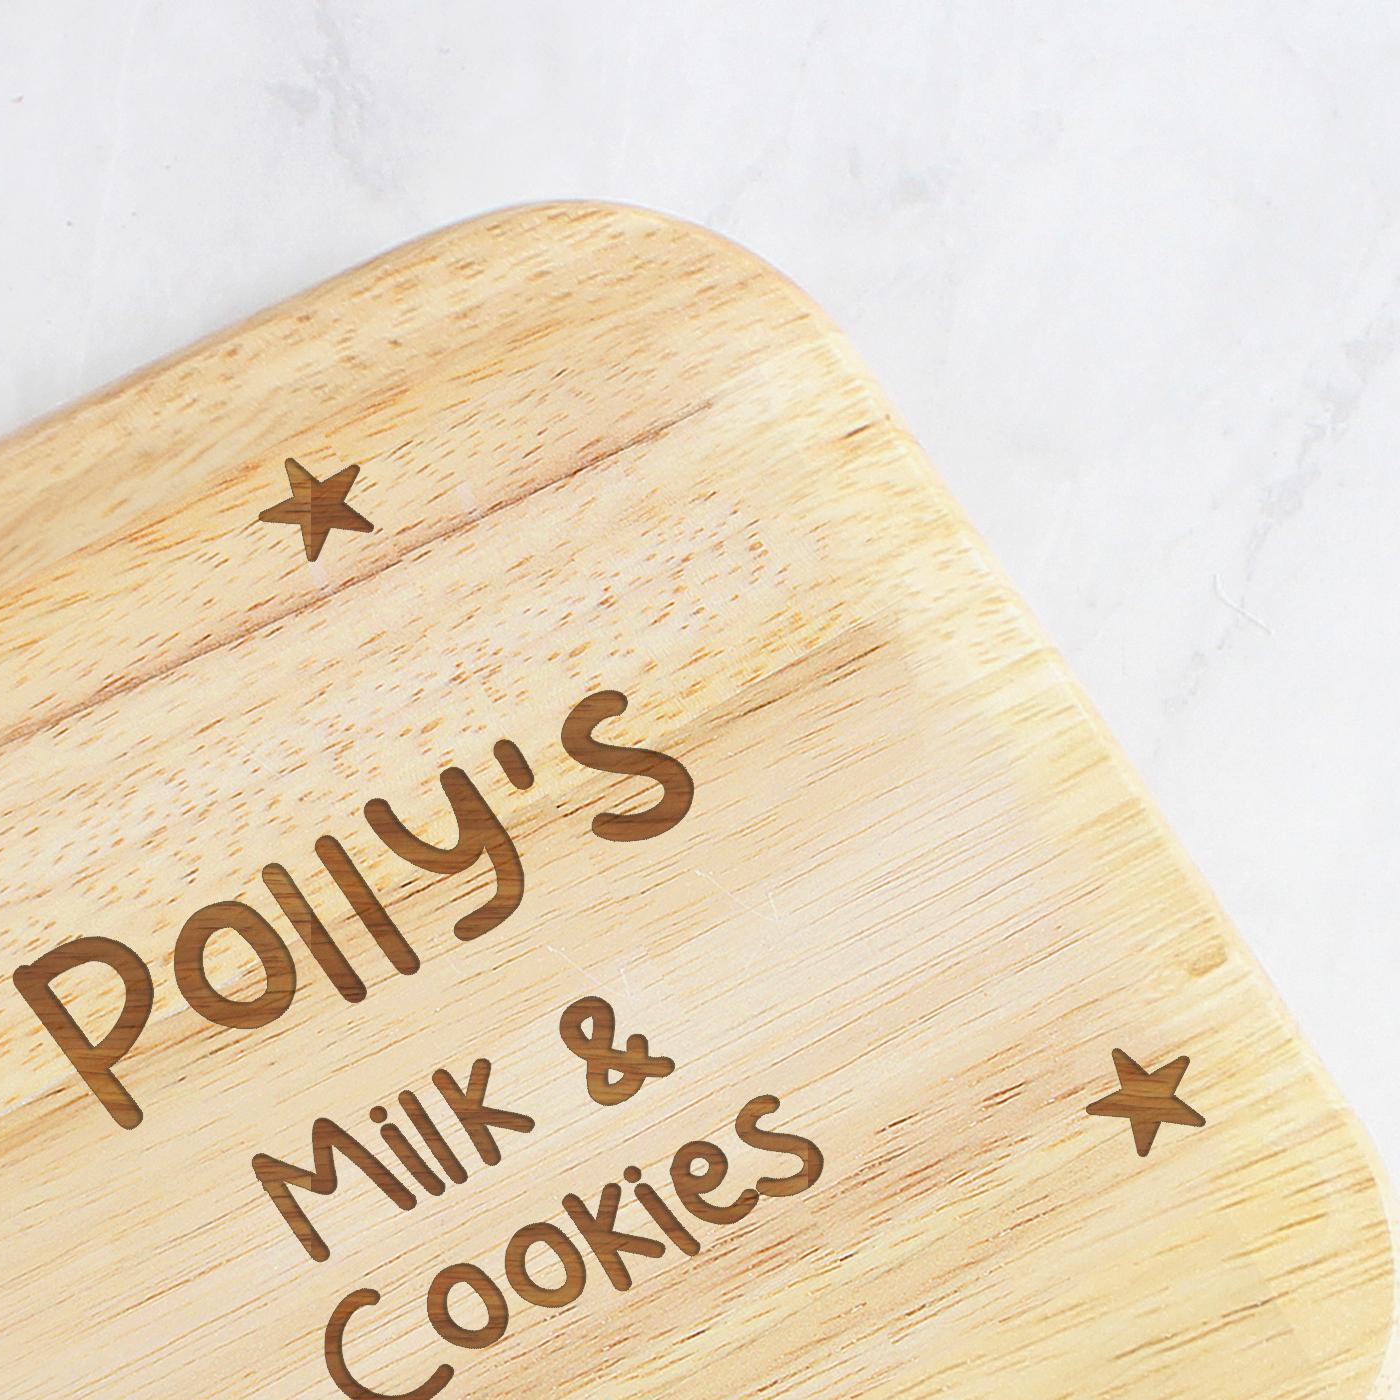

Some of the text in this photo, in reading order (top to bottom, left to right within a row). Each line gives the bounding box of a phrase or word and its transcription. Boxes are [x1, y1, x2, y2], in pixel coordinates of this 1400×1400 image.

[12, 689, 695, 1131] Polly's
[251, 995, 676, 1263] Milk &
